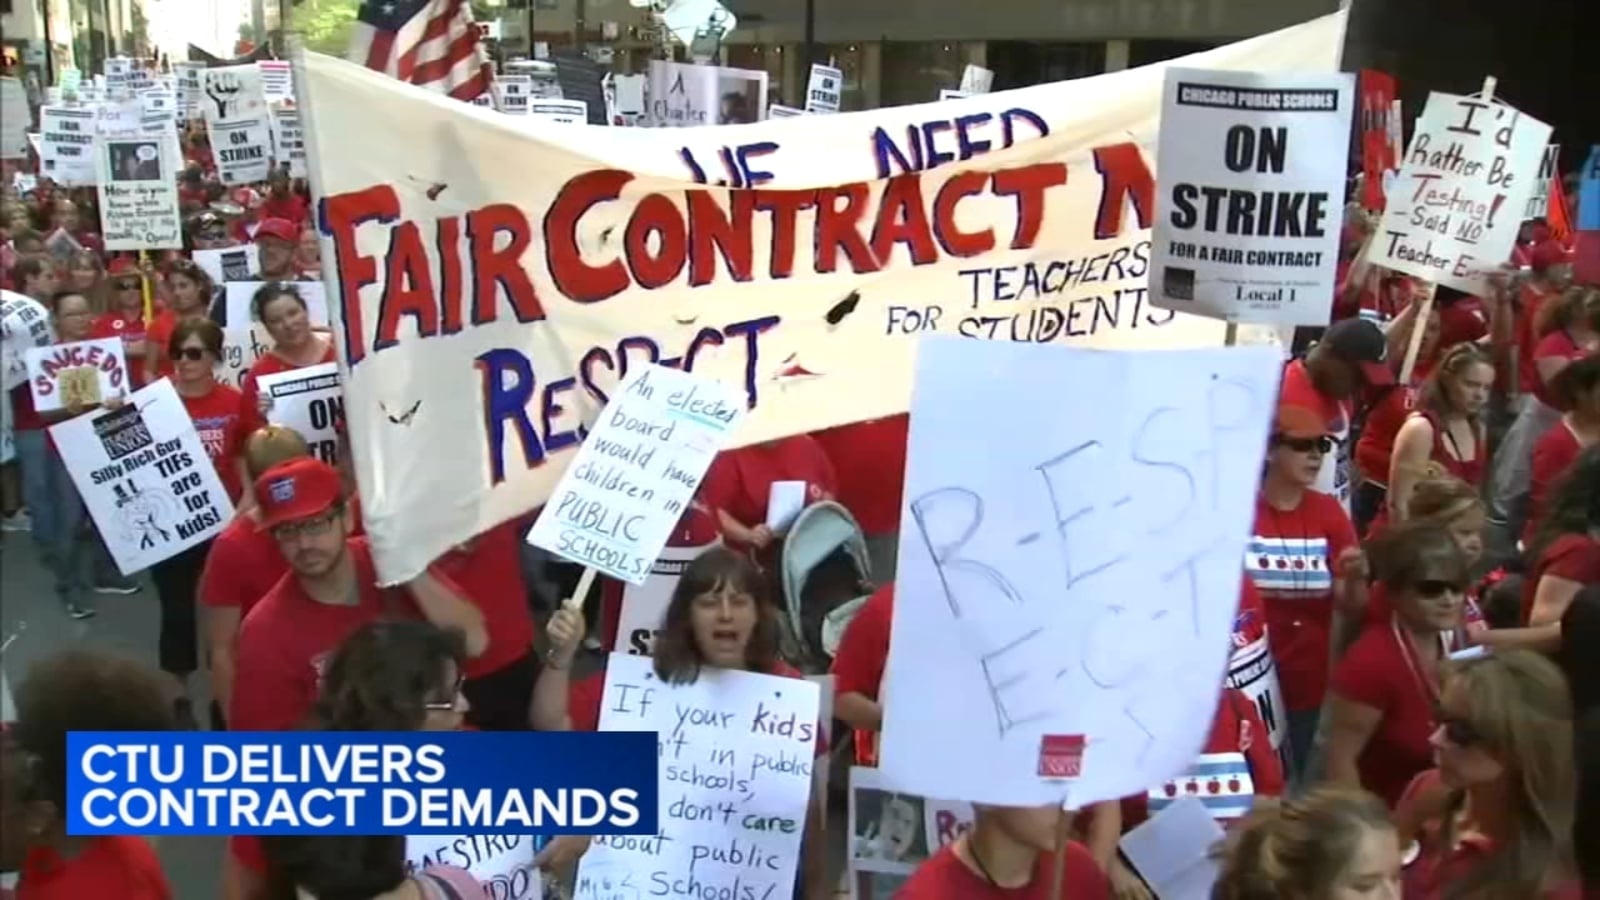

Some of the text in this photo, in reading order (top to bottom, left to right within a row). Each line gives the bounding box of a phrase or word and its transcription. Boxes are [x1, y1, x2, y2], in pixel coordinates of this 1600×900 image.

[811, 90, 839, 106] STRIKE
[822, 78, 835, 89] ON
[1181, 87, 1334, 109] CHICAGO PUBLIC SCHOOLS
[229, 130, 248, 145] ON
[1446, 101, 1520, 150] I'd
[220, 146, 263, 162] STRIKE
[677, 140, 780, 190] WE
[1225, 124, 1288, 173] ON
[1410, 133, 1515, 189] Rather Be
[1170, 183, 1329, 238] STRIKE
[1411, 173, 1507, 230] Testing!
[1386, 230, 1450, 269] Teacher
[1455, 220, 1483, 244] NO
[318, 183, 547, 370] FAIR
[543, 162, 1068, 304] CONTRACT
[1170, 241, 1323, 267] FOR A FAIR CONTRACT
[957, 240, 1151, 309] TEACHERS
[1236, 286, 1283, 301] Local
[886, 305, 944, 336] FOR
[35, 346, 123, 396] SAUCEDO
[308, 396, 344, 430] ON
[627, 370, 738, 425] An elected
[610, 404, 677, 442] board
[90, 437, 183, 485] Silly Rich Guy
[153, 452, 194, 478] TIFs
[593, 436, 697, 490] would have
[171, 471, 202, 496] are
[183, 490, 211, 513] for
[574, 461, 682, 516] children in
[175, 507, 221, 541] kids!
[555, 491, 647, 543] PUBLIC
[556, 529, 652, 581] SCHOOLS!
[611, 684, 813, 743] If your kids
[710, 742, 735, 767] in
[752, 749, 813, 781] public
[667, 765, 755, 801] schools,
[668, 795, 798, 834] don't care
[594, 828, 780, 872] about public
